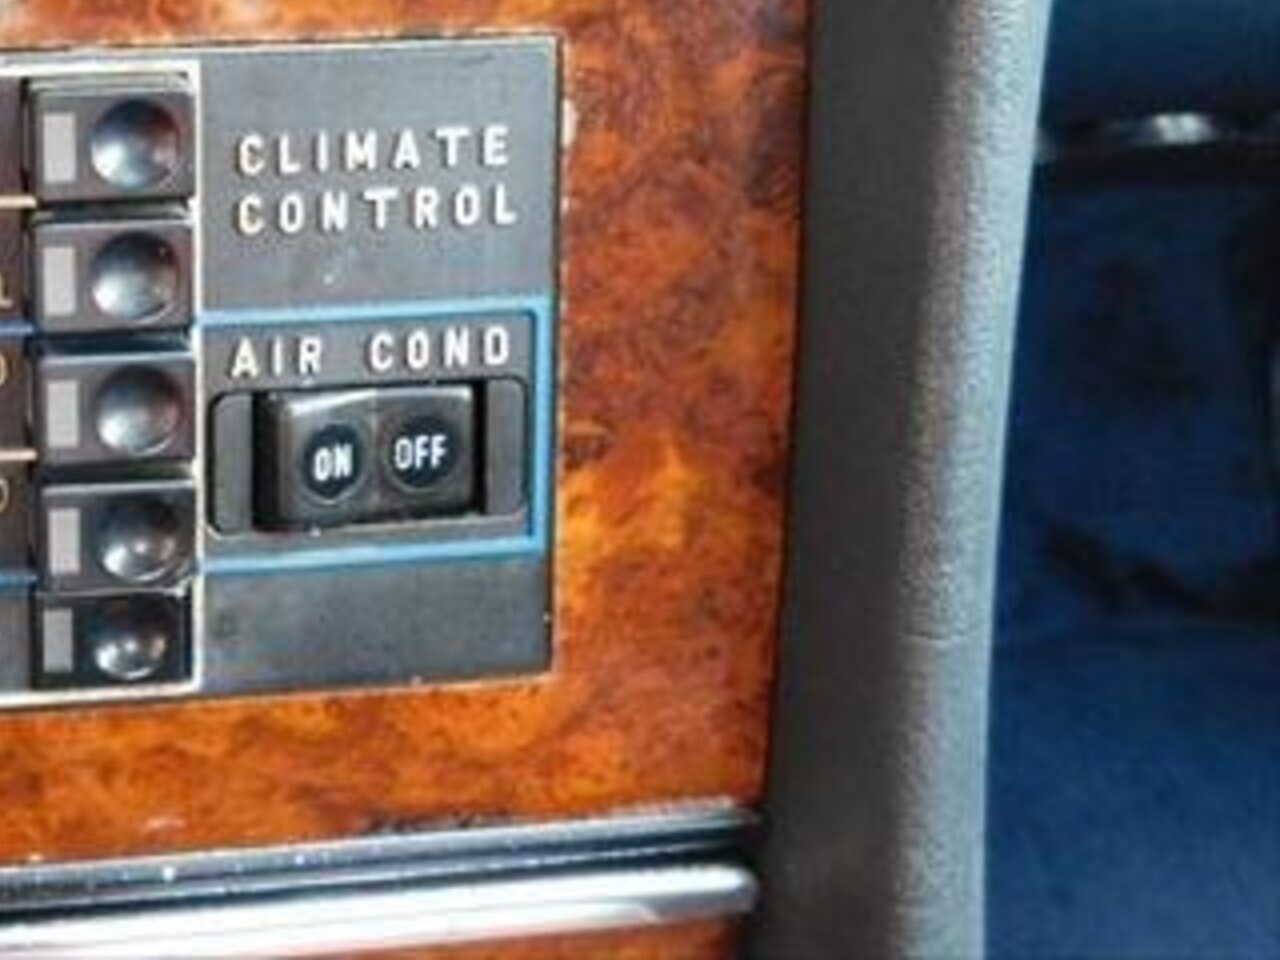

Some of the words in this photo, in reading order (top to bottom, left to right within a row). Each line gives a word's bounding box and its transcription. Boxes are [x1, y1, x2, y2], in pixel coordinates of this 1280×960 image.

[238, 125, 512, 177] CLIMATE
[238, 184, 519, 237] CONTROL
[231, 336, 322, 380] AIR
[370, 327, 511, 372] COND
[314, 443, 352, 481] ON
[395, 435, 448, 471] OFF
